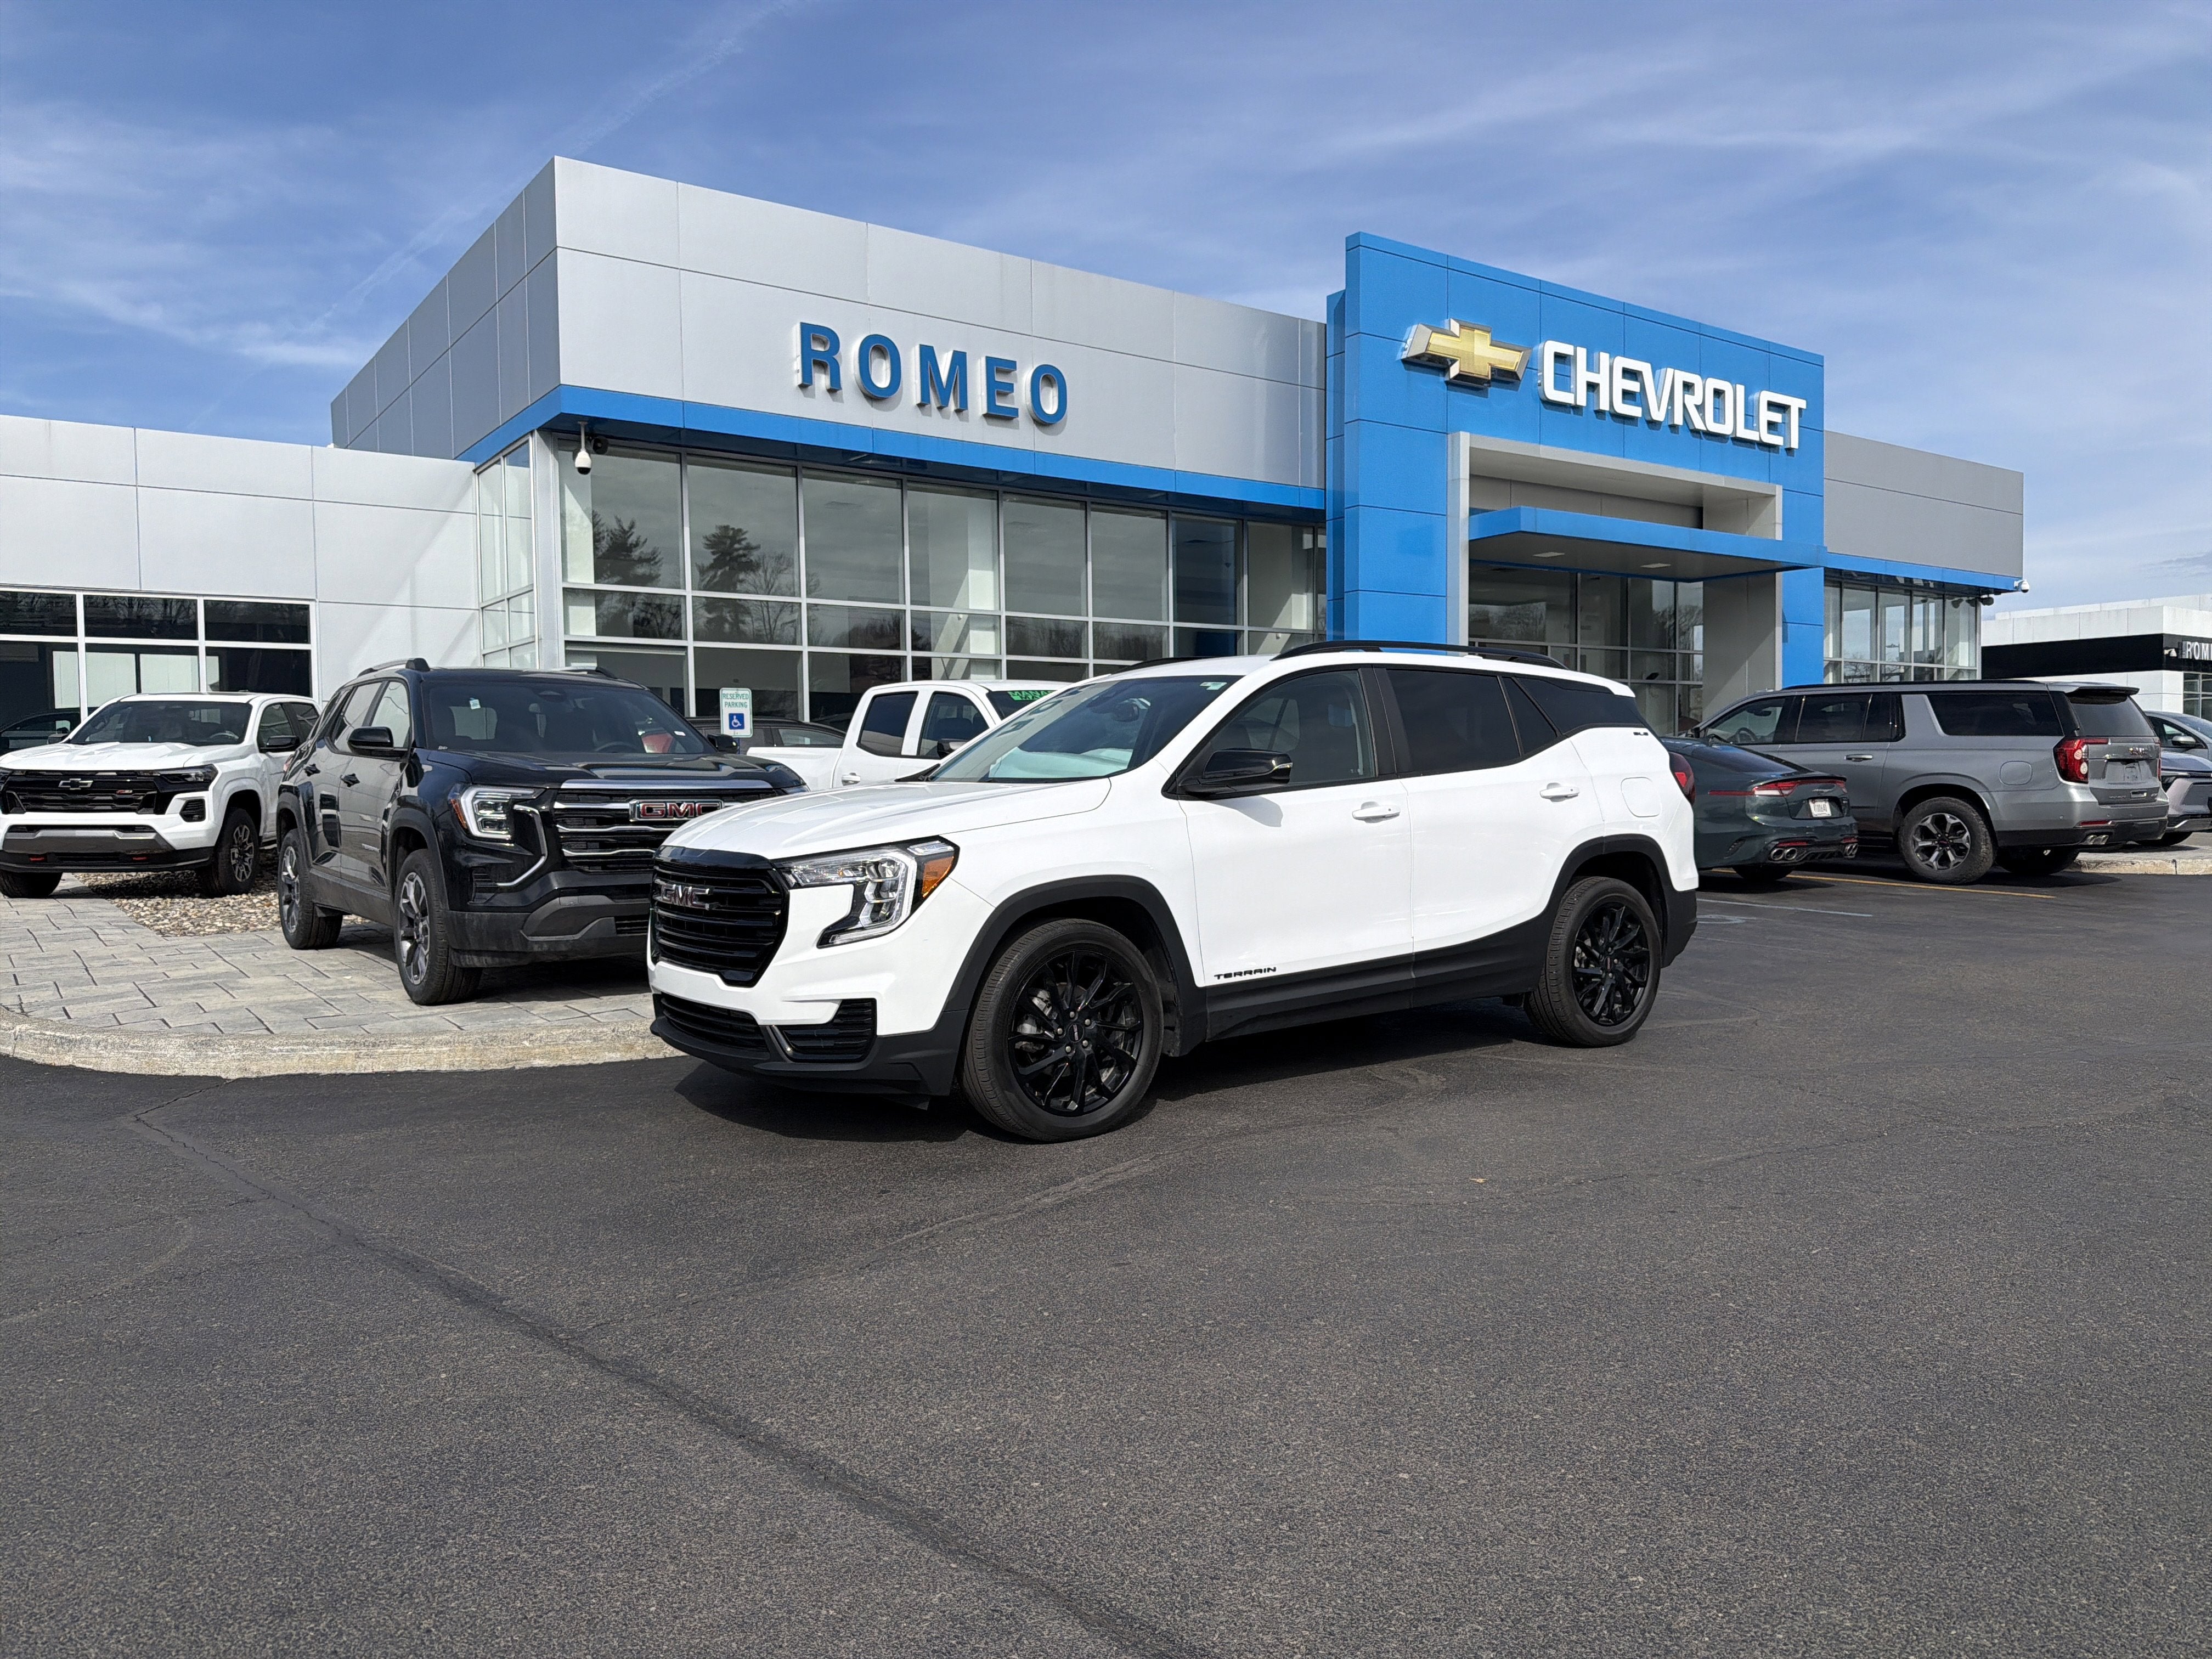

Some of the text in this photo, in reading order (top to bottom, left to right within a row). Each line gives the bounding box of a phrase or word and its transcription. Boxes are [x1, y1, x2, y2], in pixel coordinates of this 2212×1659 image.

[798, 322, 1067, 425] ROMEO
[1540, 340, 1807, 449] CHEVROLET
[2186, 641, 2212, 661] ROM
[640, 802, 720, 818] GMC
[661, 884, 709, 911] GMC
[1214, 967, 1276, 980] TERRAIN
